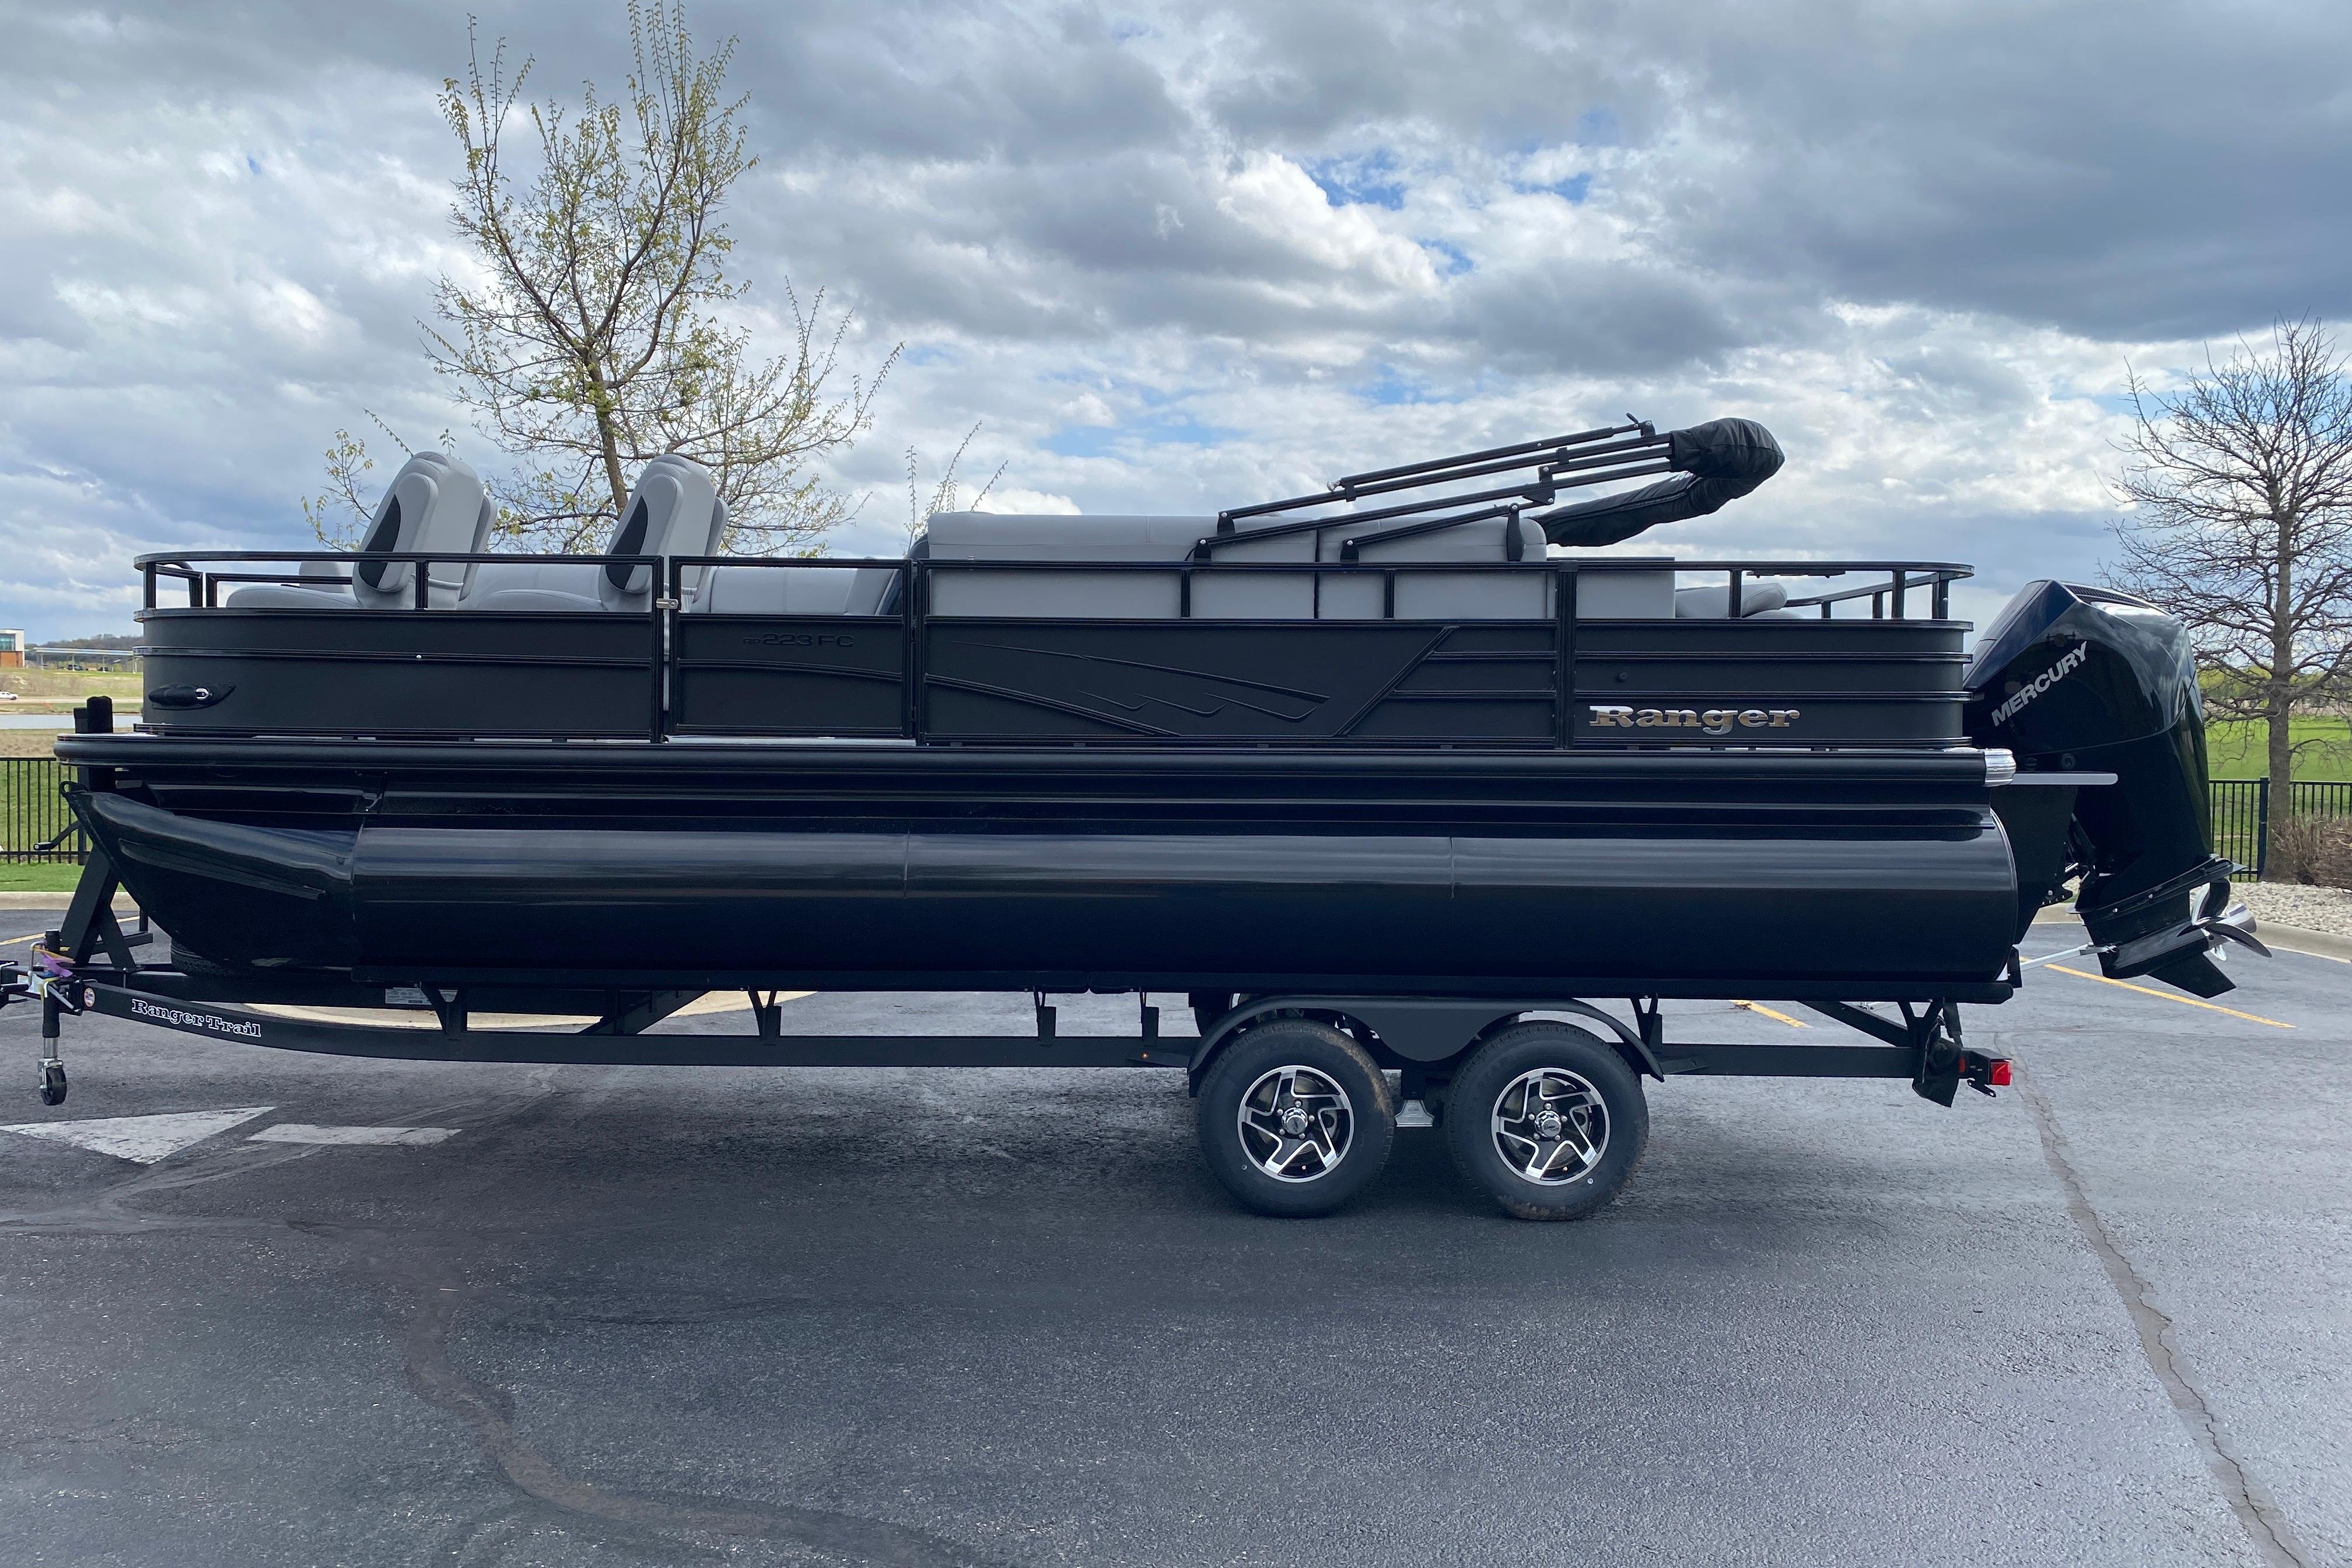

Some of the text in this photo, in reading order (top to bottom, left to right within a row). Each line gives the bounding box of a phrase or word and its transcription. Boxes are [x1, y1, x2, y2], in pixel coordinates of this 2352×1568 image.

[762, 632, 813, 646] 223
[817, 634, 855, 648] FC
[1991, 640, 2087, 727] MERCURY
[1588, 705, 1801, 736] Ranger
[131, 999, 262, 1037] Ranger Trail
